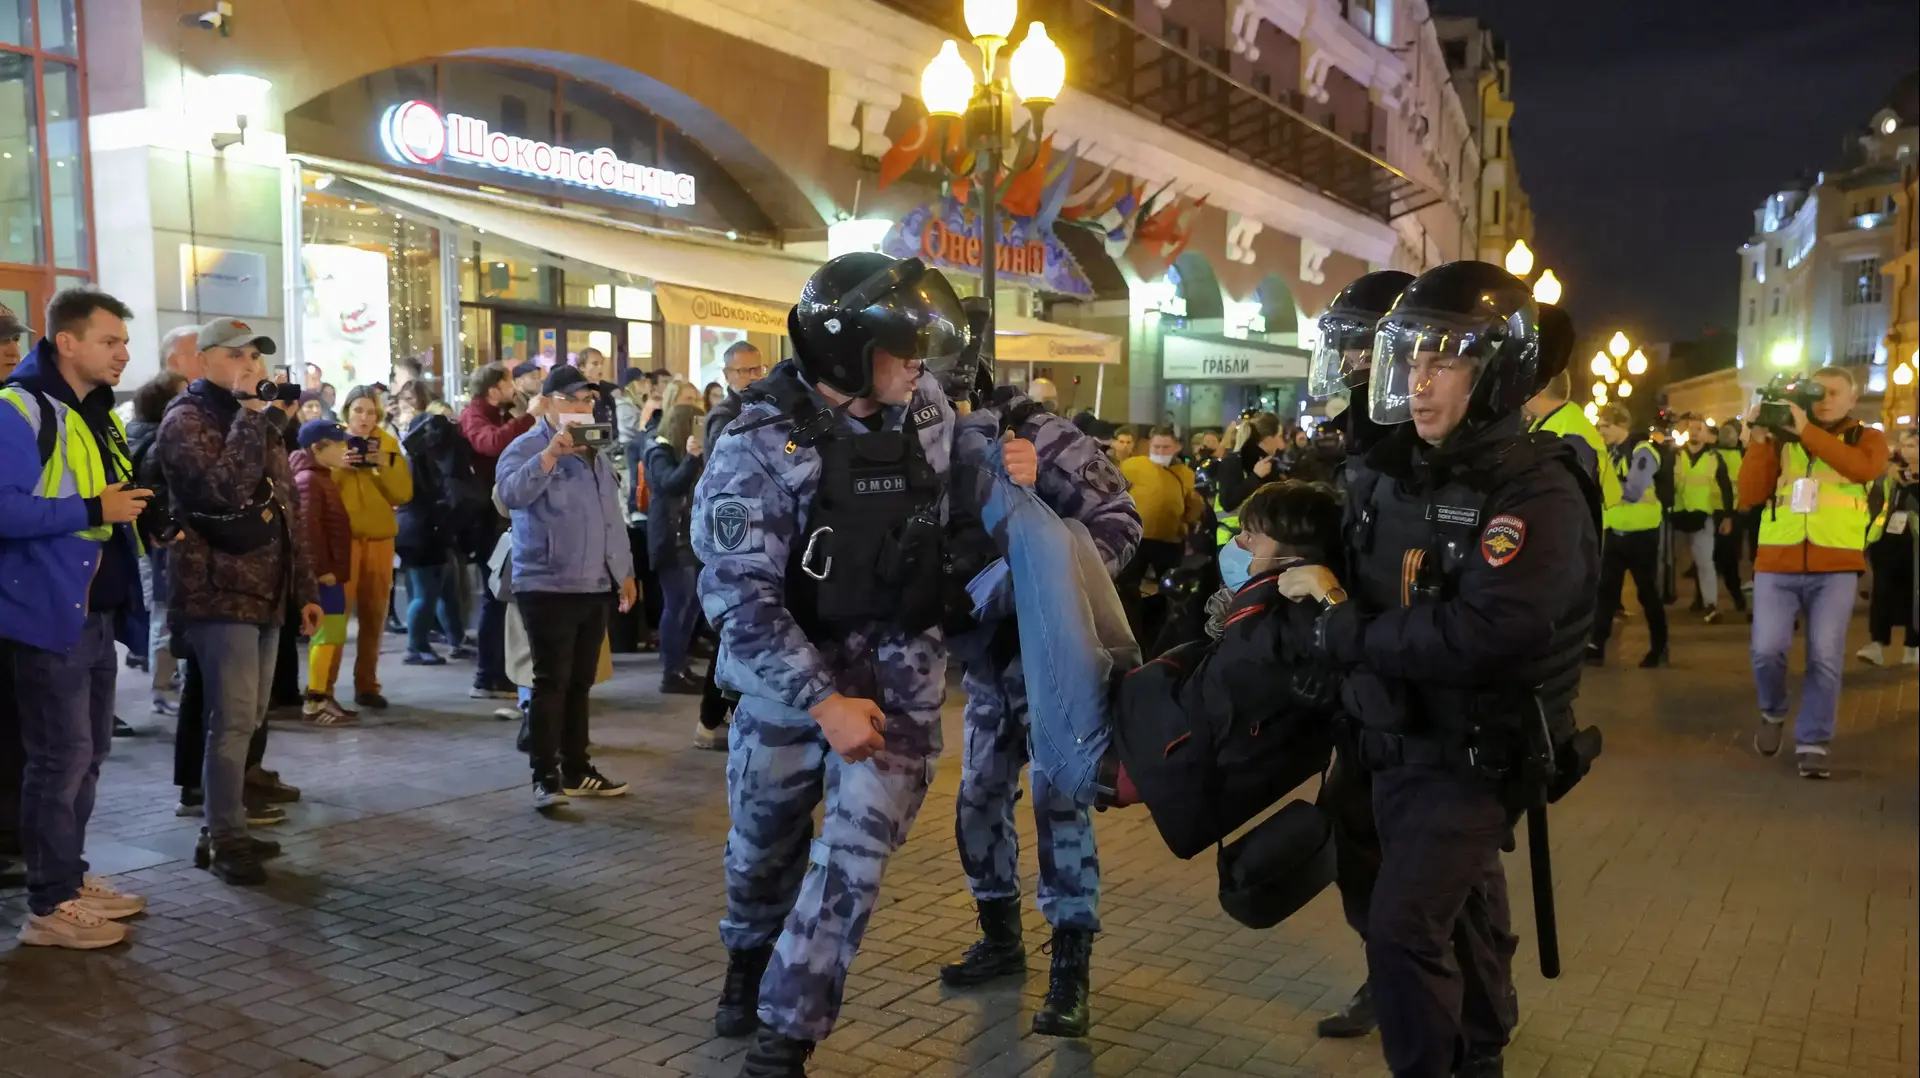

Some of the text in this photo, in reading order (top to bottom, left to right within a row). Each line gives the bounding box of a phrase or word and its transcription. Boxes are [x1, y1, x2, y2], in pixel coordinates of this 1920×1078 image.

[449, 114, 694, 205] Шоколадница
[1203, 357, 1249, 374] ГРАБЛИ
[857, 478, 903, 492] ОМОН
[1487, 526, 1520, 540] РОССИЯ
